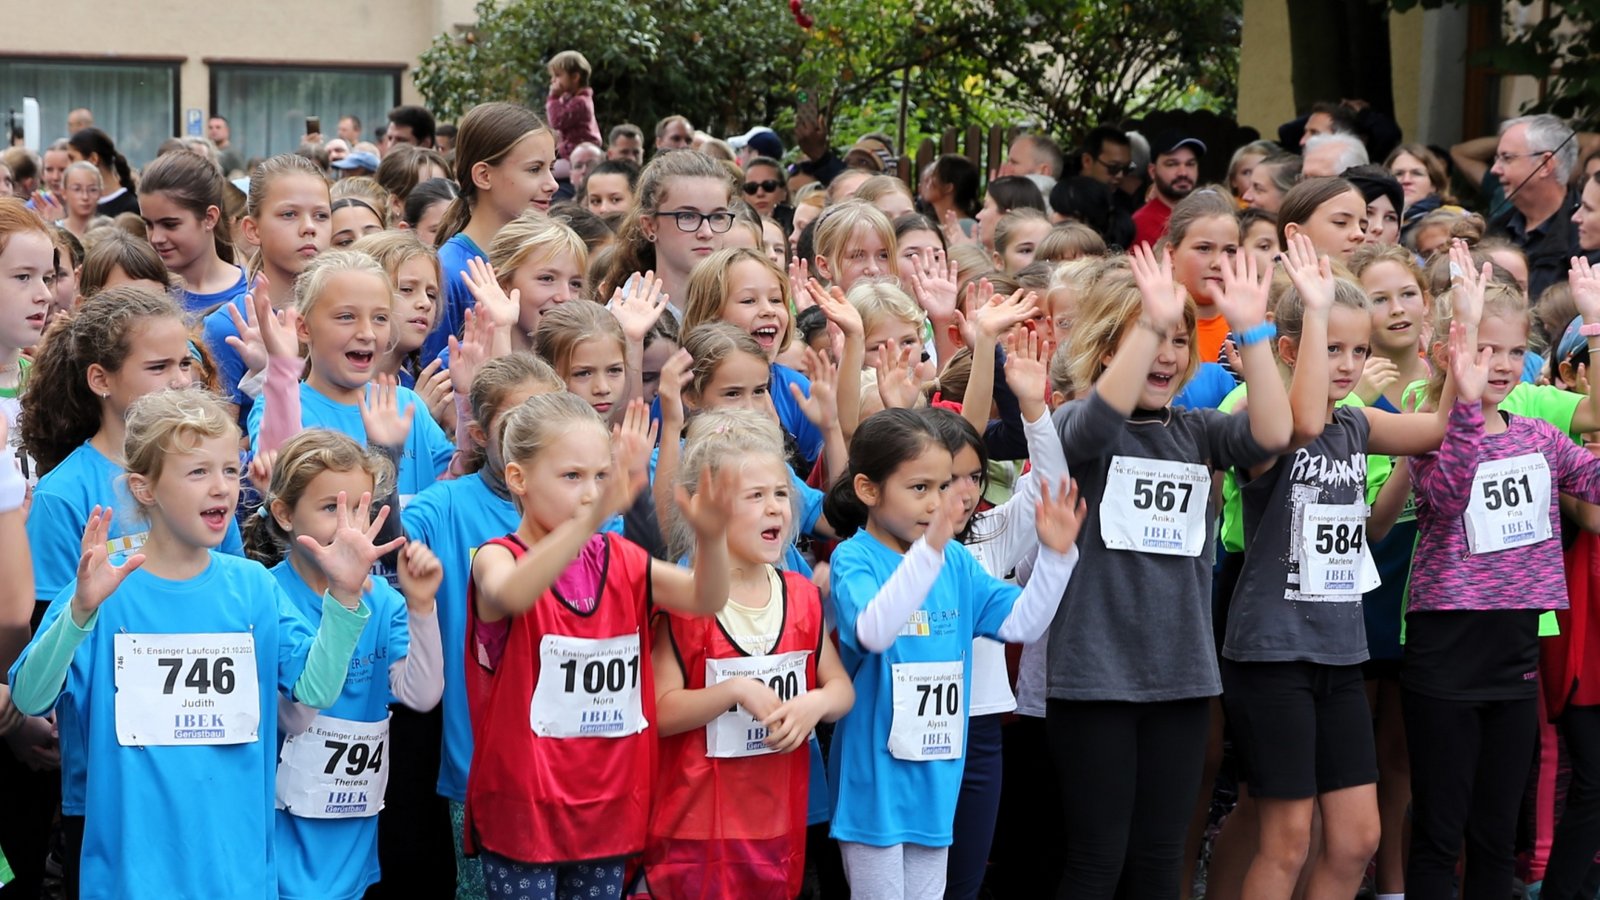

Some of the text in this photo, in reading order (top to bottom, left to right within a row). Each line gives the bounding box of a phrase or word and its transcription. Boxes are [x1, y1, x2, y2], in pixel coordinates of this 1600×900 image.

[1127, 469, 1156, 478] Ensinger
[1158, 471, 1185, 481] Laufcup
[1133, 478, 1193, 513] 567
[1482, 474, 1533, 511] 561
[1151, 514, 1175, 523] Anika
[1144, 526, 1182, 541] IBEK
[1501, 520, 1534, 535] IBEK
[1315, 524, 1363, 555] 584
[1328, 557, 1353, 565] Marlene
[1325, 570, 1355, 581] IBEK
[146, 647, 184, 656] Ensinger
[186, 647, 220, 656] Laufcup
[221, 646, 253, 654] 21.10.2023
[562, 649, 596, 660] Ensinger
[596, 648, 623, 657] Laufcup
[158, 657, 235, 695] 746
[560, 655, 639, 694] 1001
[722, 669, 755, 677] Ensinger
[181, 699, 215, 708] Judith
[593, 697, 614, 705] Nora
[916, 683, 959, 716] 710
[175, 714, 225, 727] IBEK
[581, 709, 623, 722] IBEK
[927, 720, 948, 730] Alyssa
[316, 726, 351, 740] Ensinger
[353, 731, 380, 742] Laufcup
[922, 732, 951, 745] IBEK
[323, 740, 384, 776] 794
[334, 777, 369, 787] Theresa
[328, 791, 368, 803] IBEK
